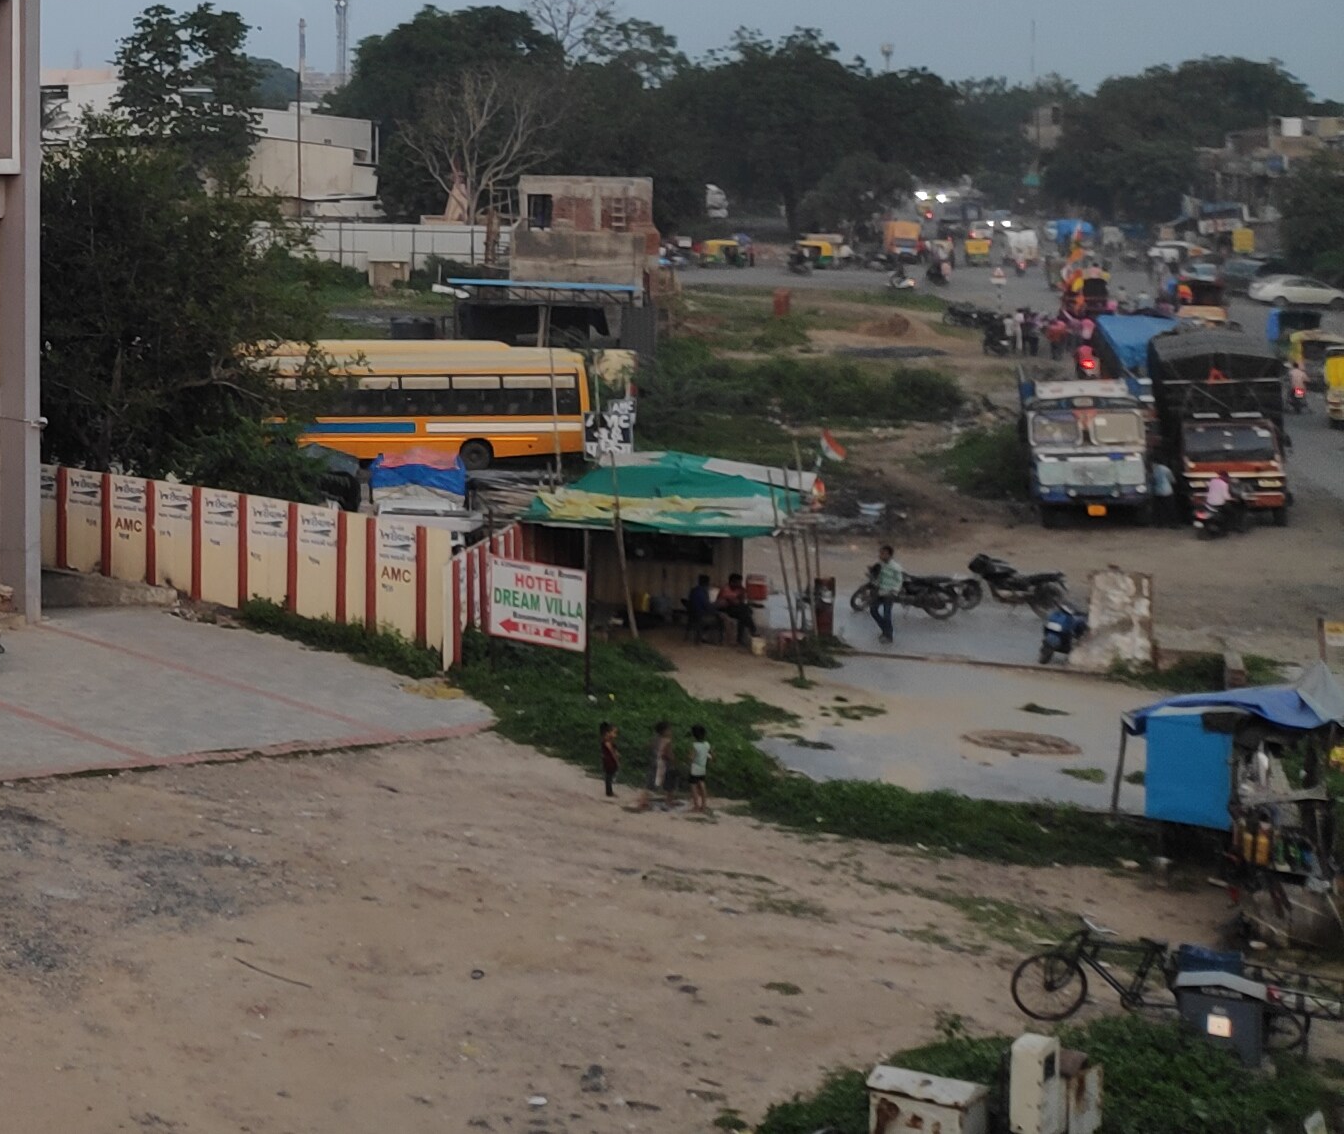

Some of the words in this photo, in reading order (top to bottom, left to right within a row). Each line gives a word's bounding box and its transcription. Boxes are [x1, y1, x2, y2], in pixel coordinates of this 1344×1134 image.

[115, 517, 142, 532] AMC
[381, 566, 411, 583] AMC
[515, 573, 561, 594] HOTEL
[494, 587, 540, 612] DREAM
[545, 597, 583, 620] VILLA
